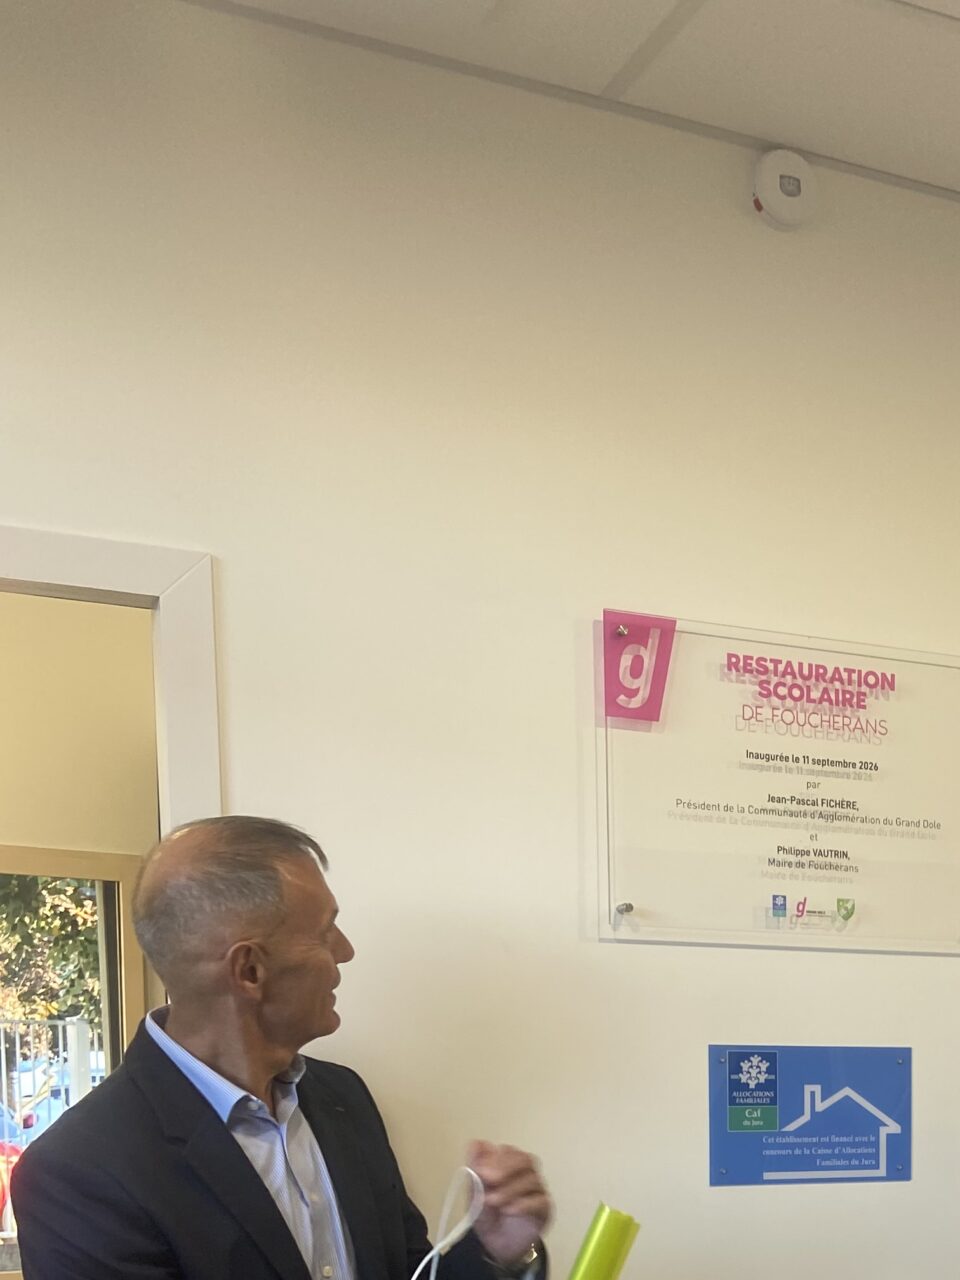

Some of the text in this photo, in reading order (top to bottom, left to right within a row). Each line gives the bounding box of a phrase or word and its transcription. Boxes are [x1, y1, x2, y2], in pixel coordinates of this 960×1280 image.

[726, 652, 896, 691] RESTAURATION
[758, 679, 867, 710] SCOLAIRE
[742, 704, 889, 736] DE FOUCHERANS
[746, 749, 879, 772] Inaugurée le 11 septembre 2026
[806, 781, 821, 790] par
[767, 794, 819, 807] Jean-Pascal
[675, 798, 721, 812] Président
[723, 803, 734, 813] de
[737, 804, 745, 814] la
[748, 805, 807, 819] Communauté
[883, 817, 893, 826] du
[895, 817, 921, 828] Grand
[922, 820, 942, 830] Dole
[809, 833, 818, 841] et
[776, 845, 851, 861] Philippe VAUTRIN,
[768, 858, 859, 873] Maire de Foucherans
[776, 1135, 819, 1143] établissement
